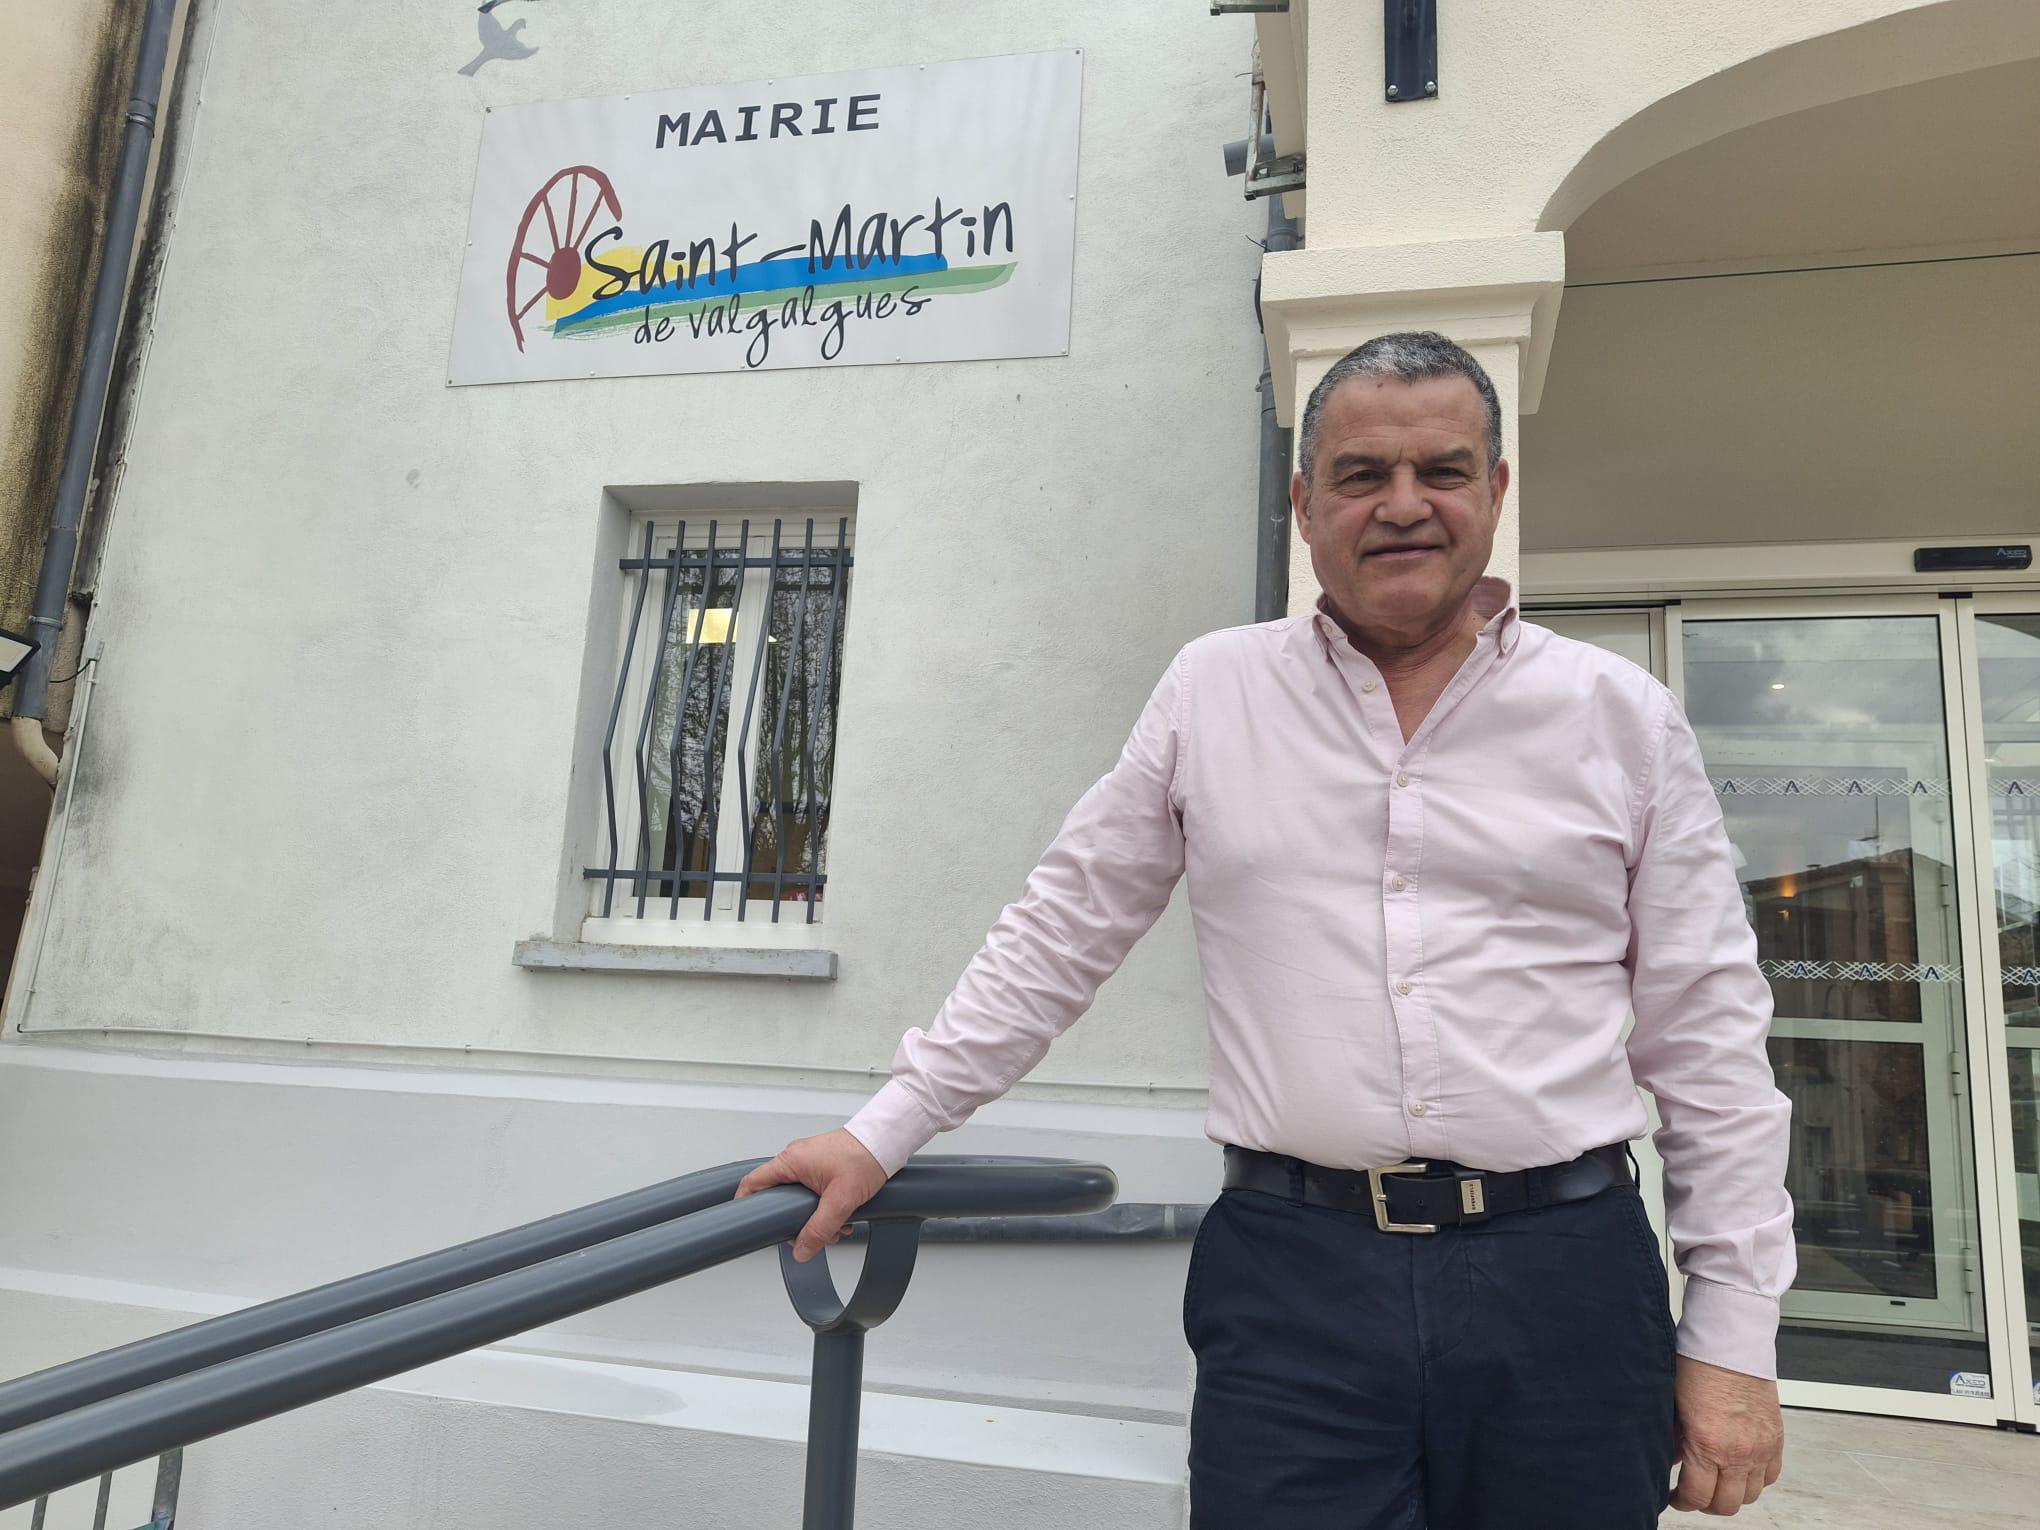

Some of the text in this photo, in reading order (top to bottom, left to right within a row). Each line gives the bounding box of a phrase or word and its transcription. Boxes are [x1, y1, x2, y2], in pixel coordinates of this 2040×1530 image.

[655, 94, 881, 149] MAIRIE
[586, 196, 1014, 300] Saint-Martin
[633, 305, 675, 346] de
